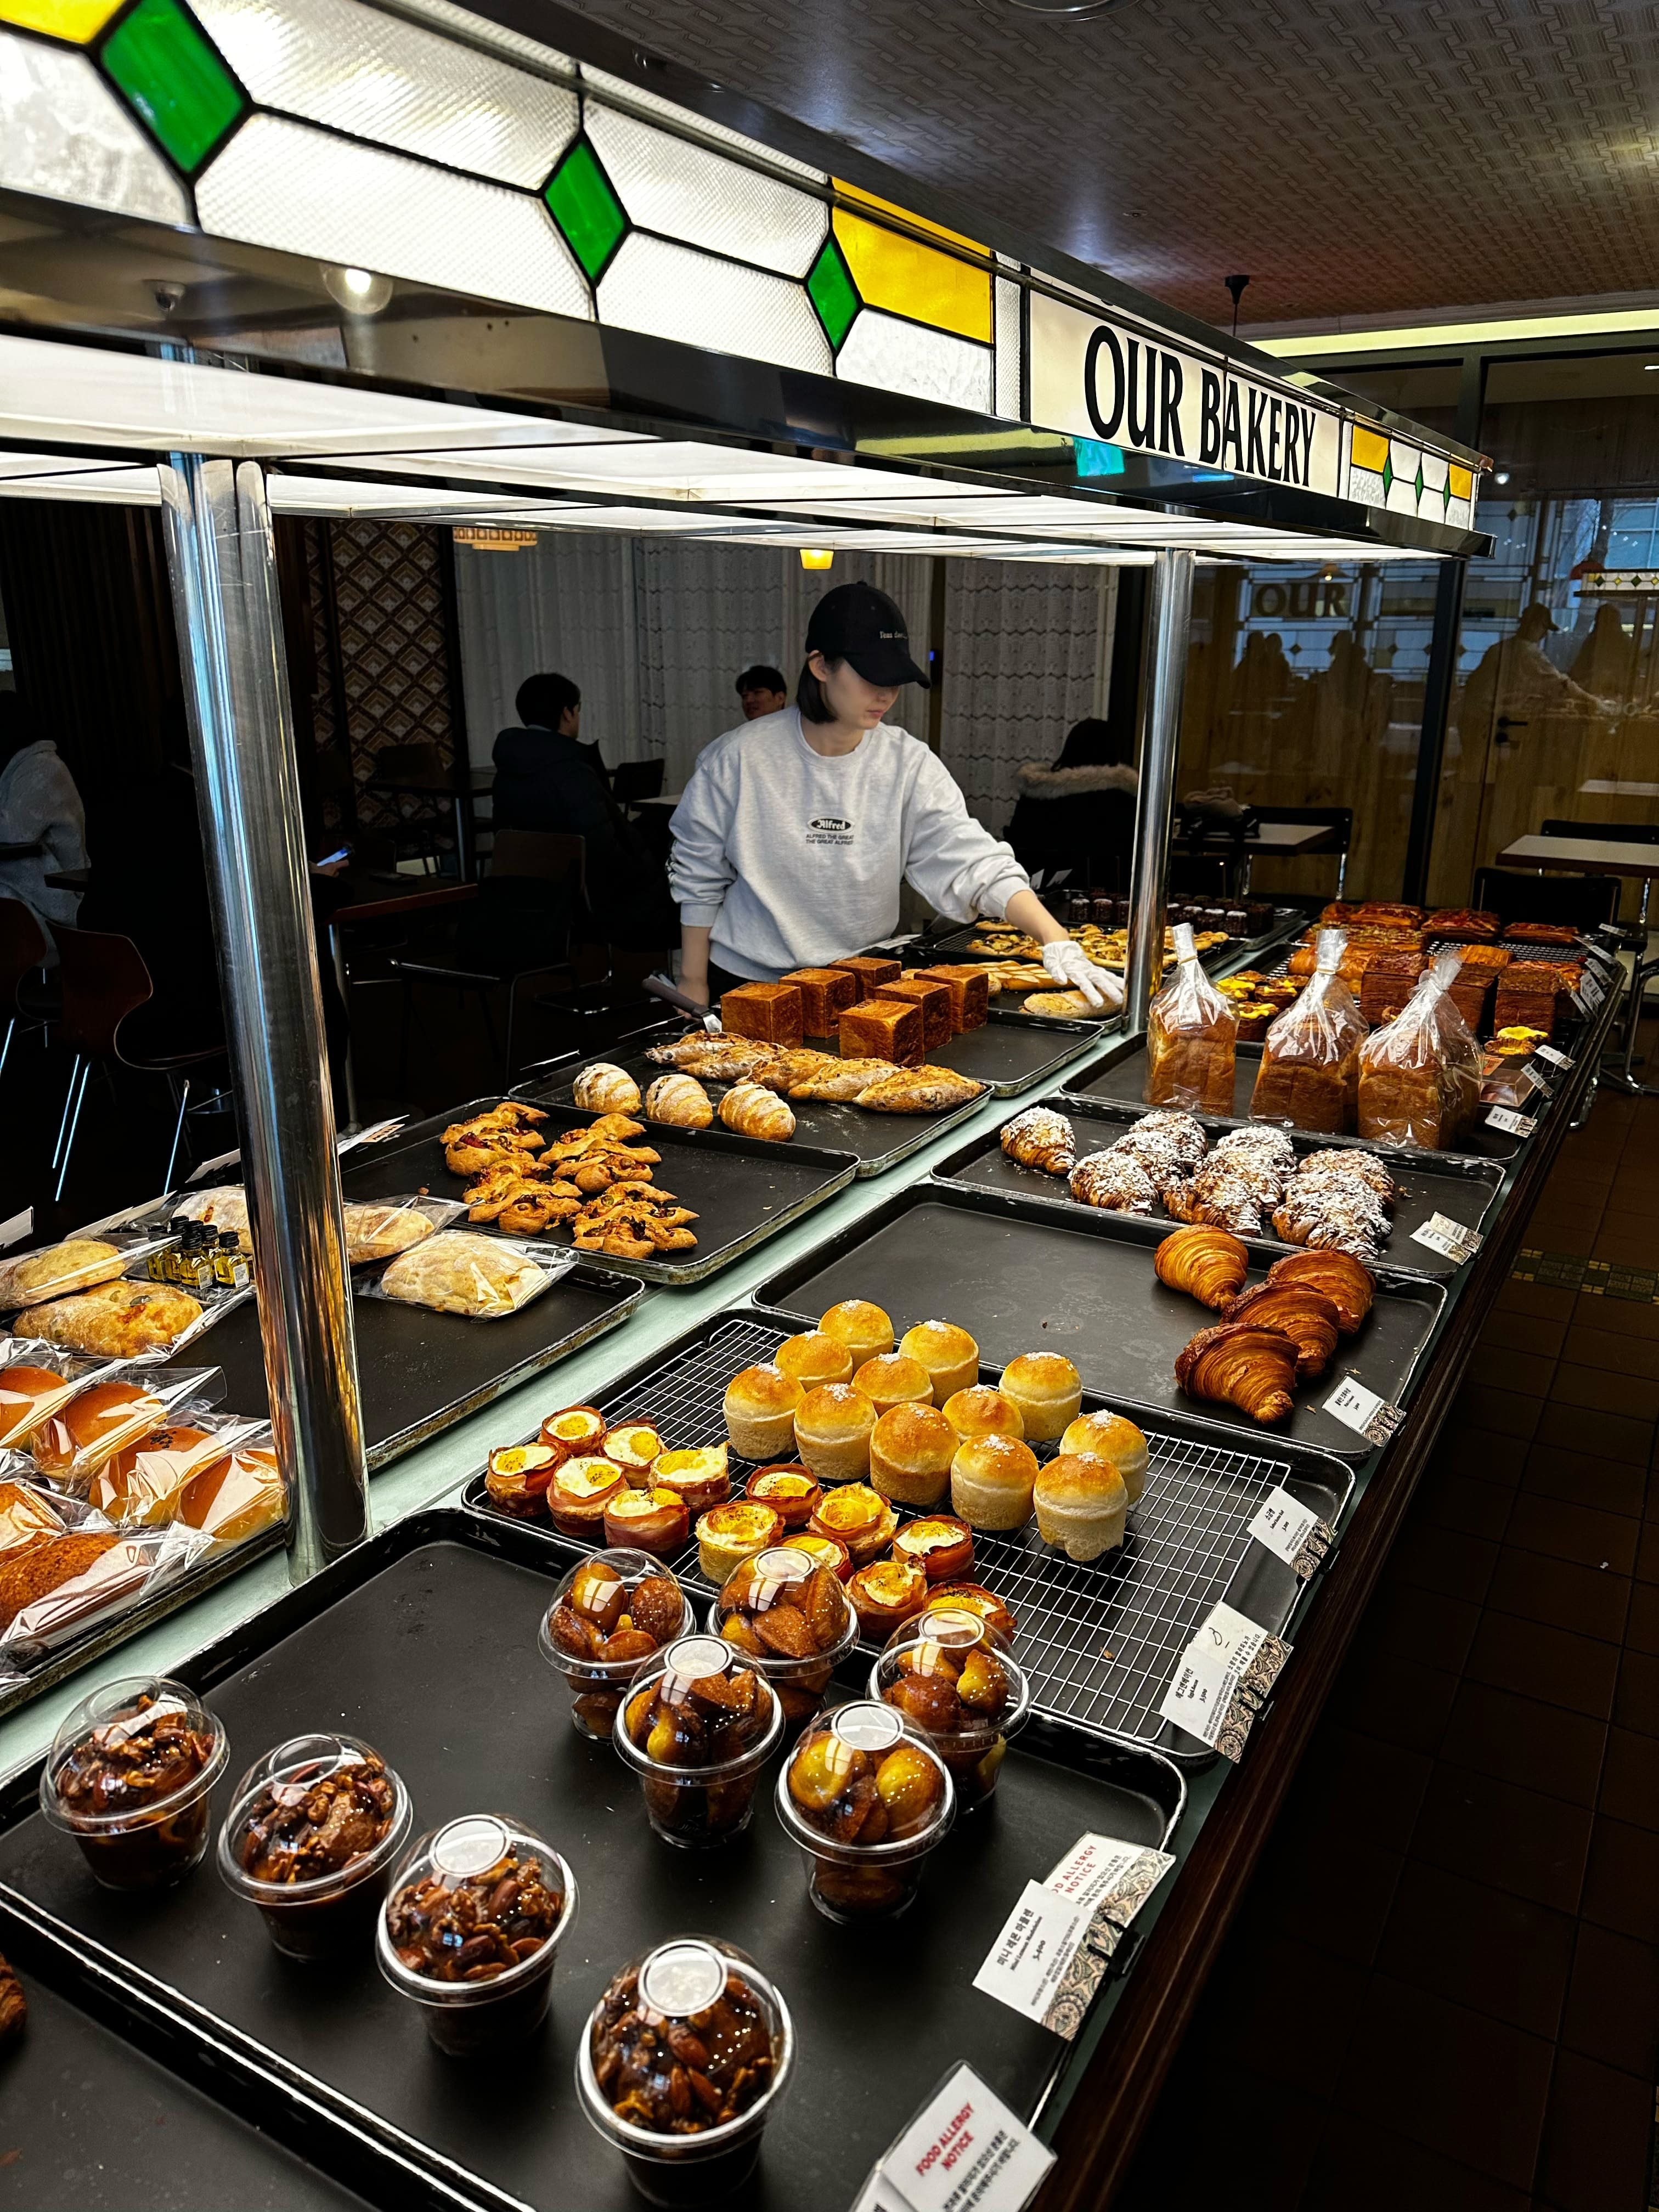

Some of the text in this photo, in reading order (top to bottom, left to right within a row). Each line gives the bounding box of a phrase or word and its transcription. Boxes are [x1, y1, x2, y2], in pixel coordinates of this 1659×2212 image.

[1084, 325, 1316, 488] OUR BAKERY
[1255, 583, 1350, 617] OUR
[816, 820, 846, 830] Alfred
[1063, 1846, 1096, 1884] ALLERGY
[1065, 1858, 1096, 1893] NOTICE
[997, 1909, 1034, 1965] 미니 레몬 마들렌
[916, 2102, 973, 2176] FOOD ALLERGY
[941, 2131, 974, 2171] NOTICE
